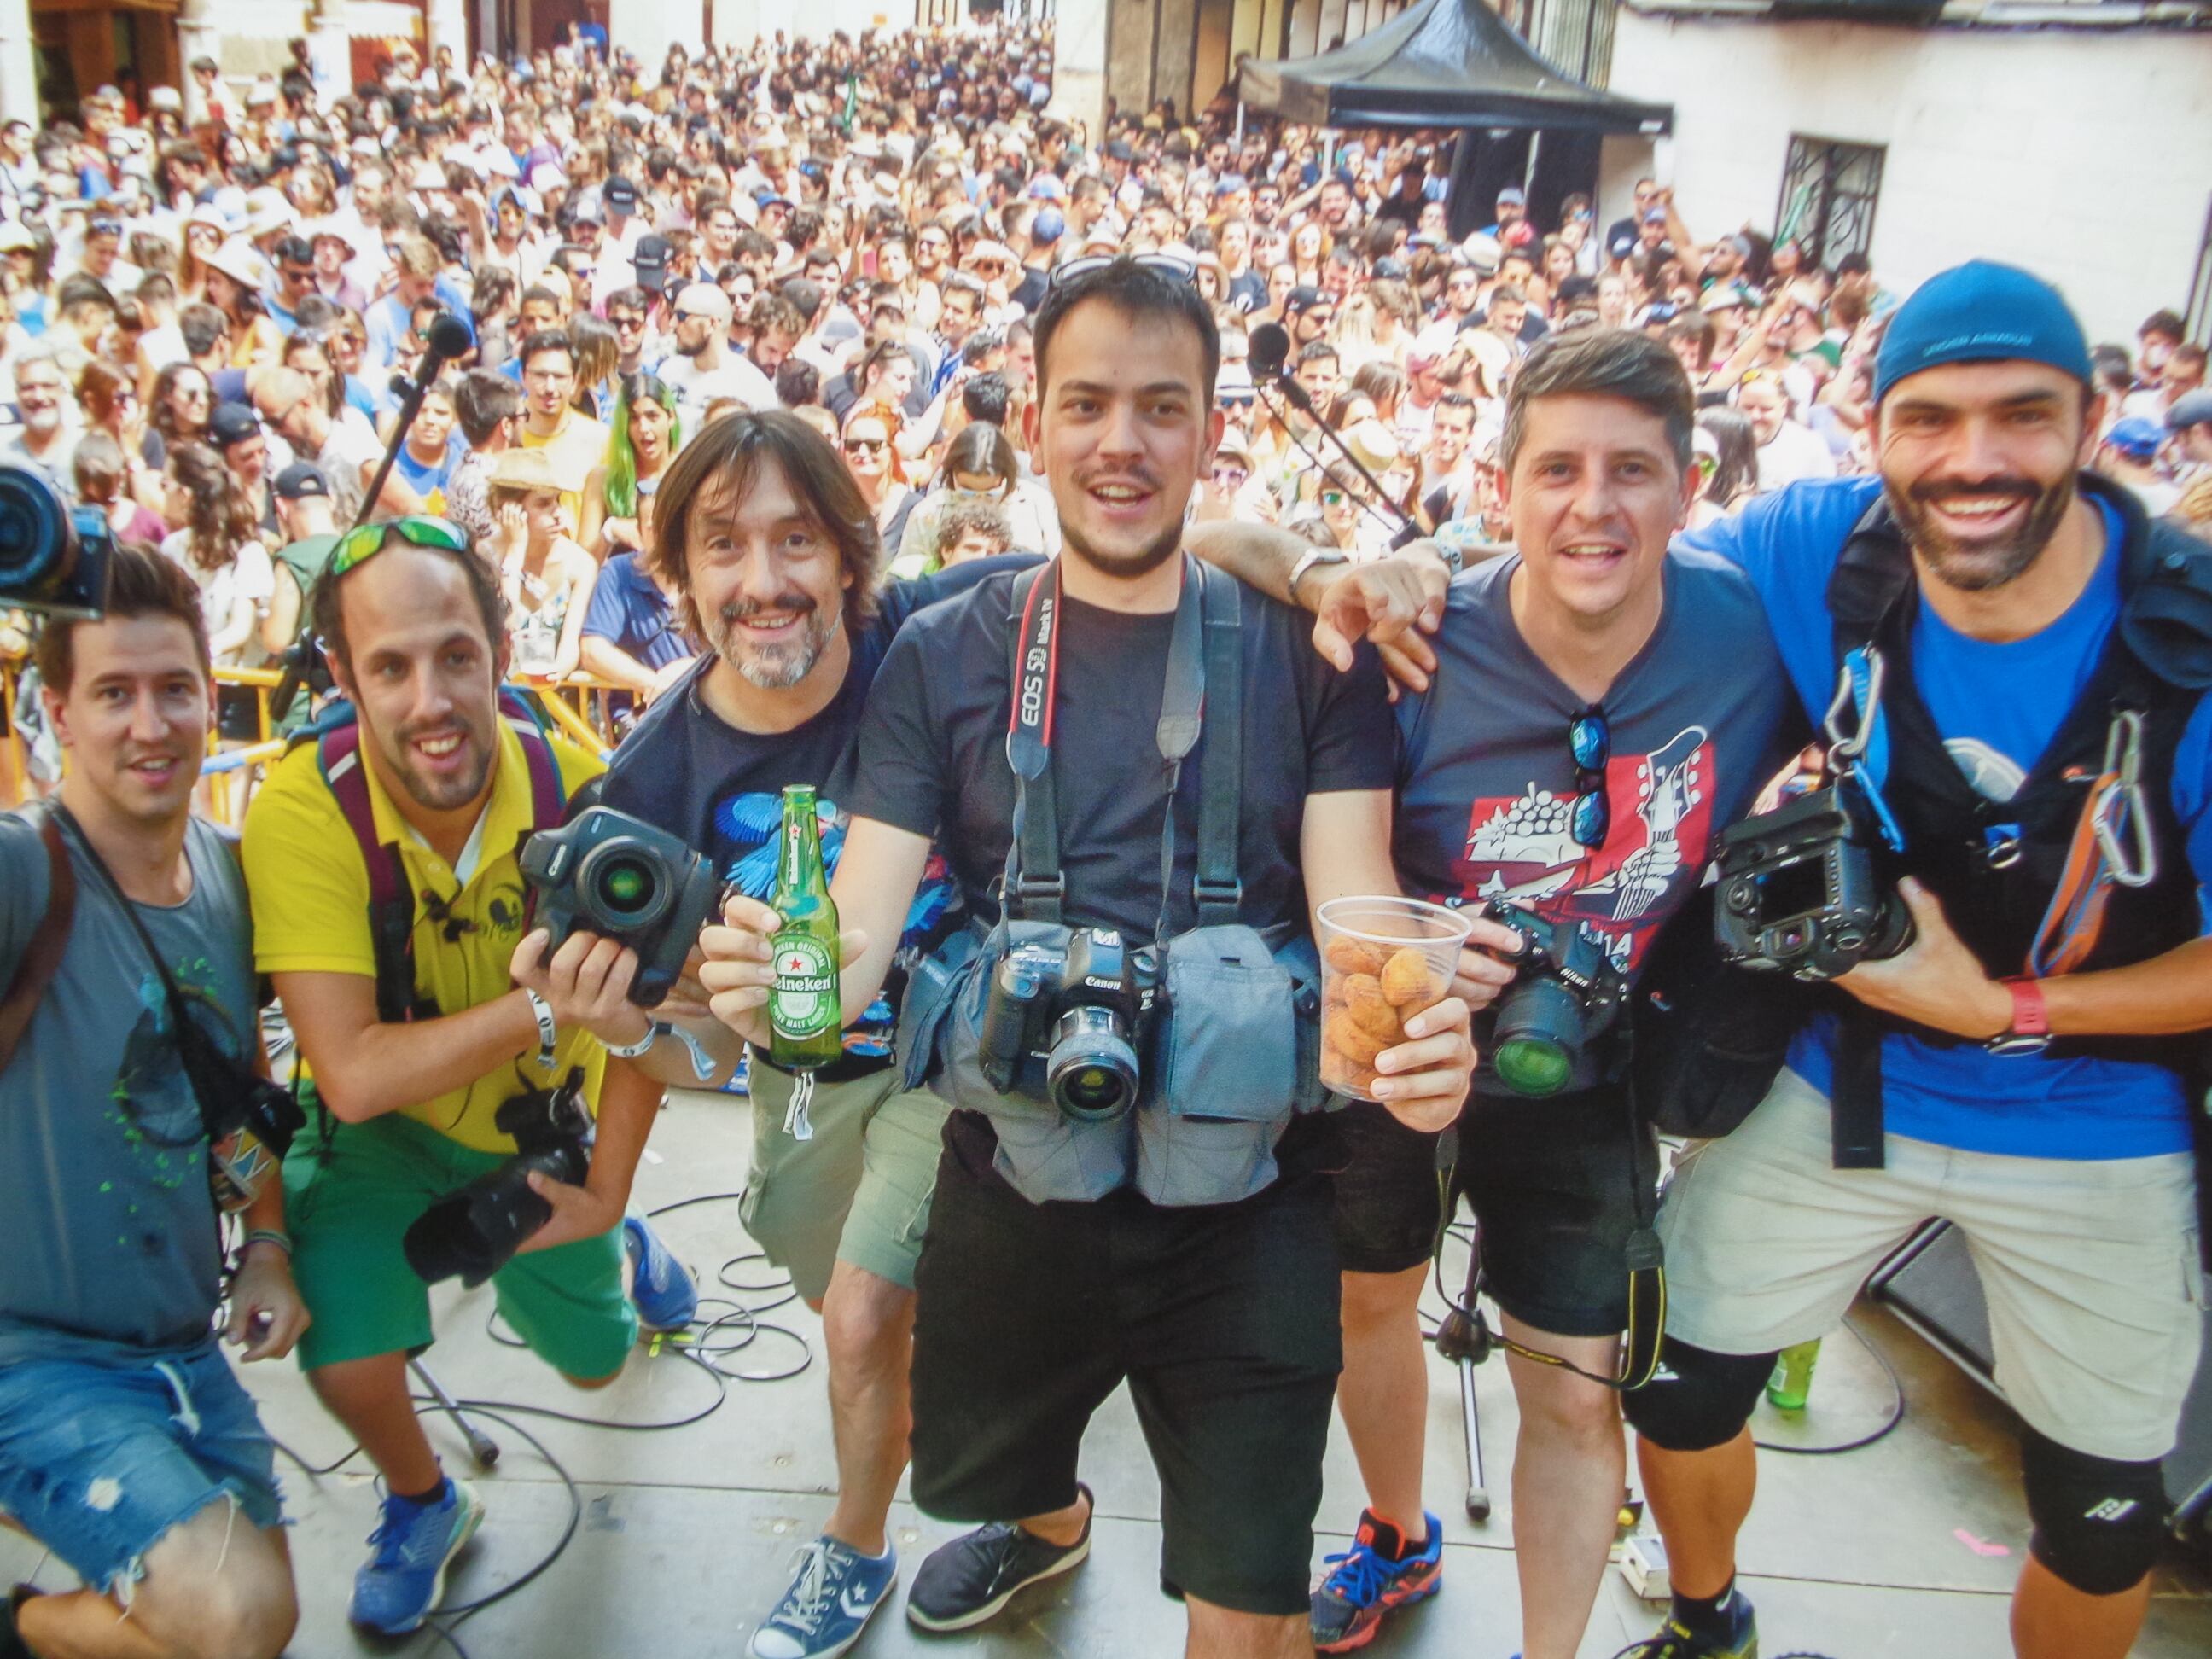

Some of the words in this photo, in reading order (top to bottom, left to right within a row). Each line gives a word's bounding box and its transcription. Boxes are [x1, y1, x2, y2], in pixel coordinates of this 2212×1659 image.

[1021, 675, 1042, 726] EOS
[1037, 611, 1051, 644] Mark
[1604, 932, 1632, 957] 14
[774, 974, 831, 992] eineken
[1084, 975, 1121, 990] Canon
